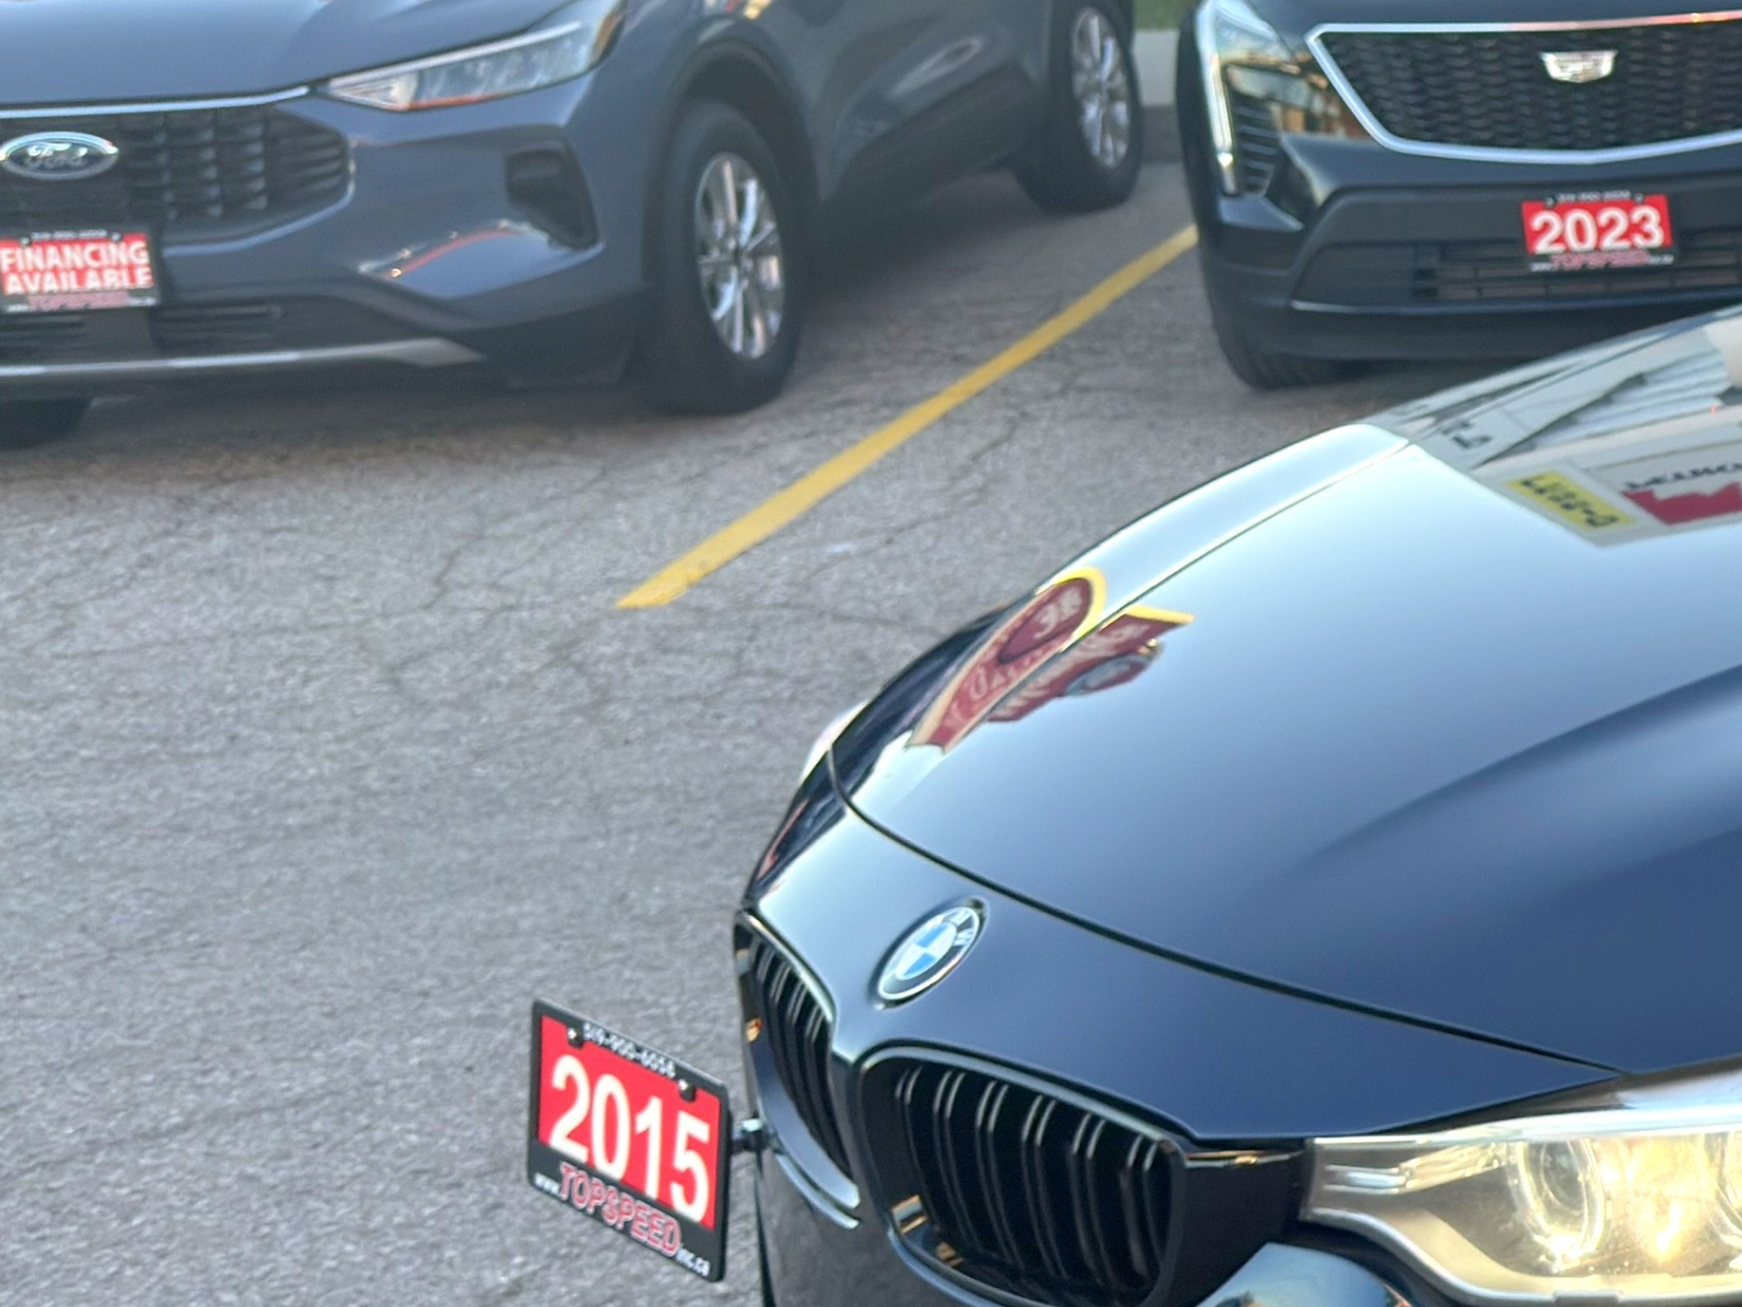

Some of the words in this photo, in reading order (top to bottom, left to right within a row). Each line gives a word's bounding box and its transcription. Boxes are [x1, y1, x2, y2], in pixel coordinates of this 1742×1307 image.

[1531, 205, 1665, 254] 2023
[1, 241, 149, 272] FINANCING
[6, 267, 152, 294] AVAILABLE
[550, 1053, 710, 1223] 2015
